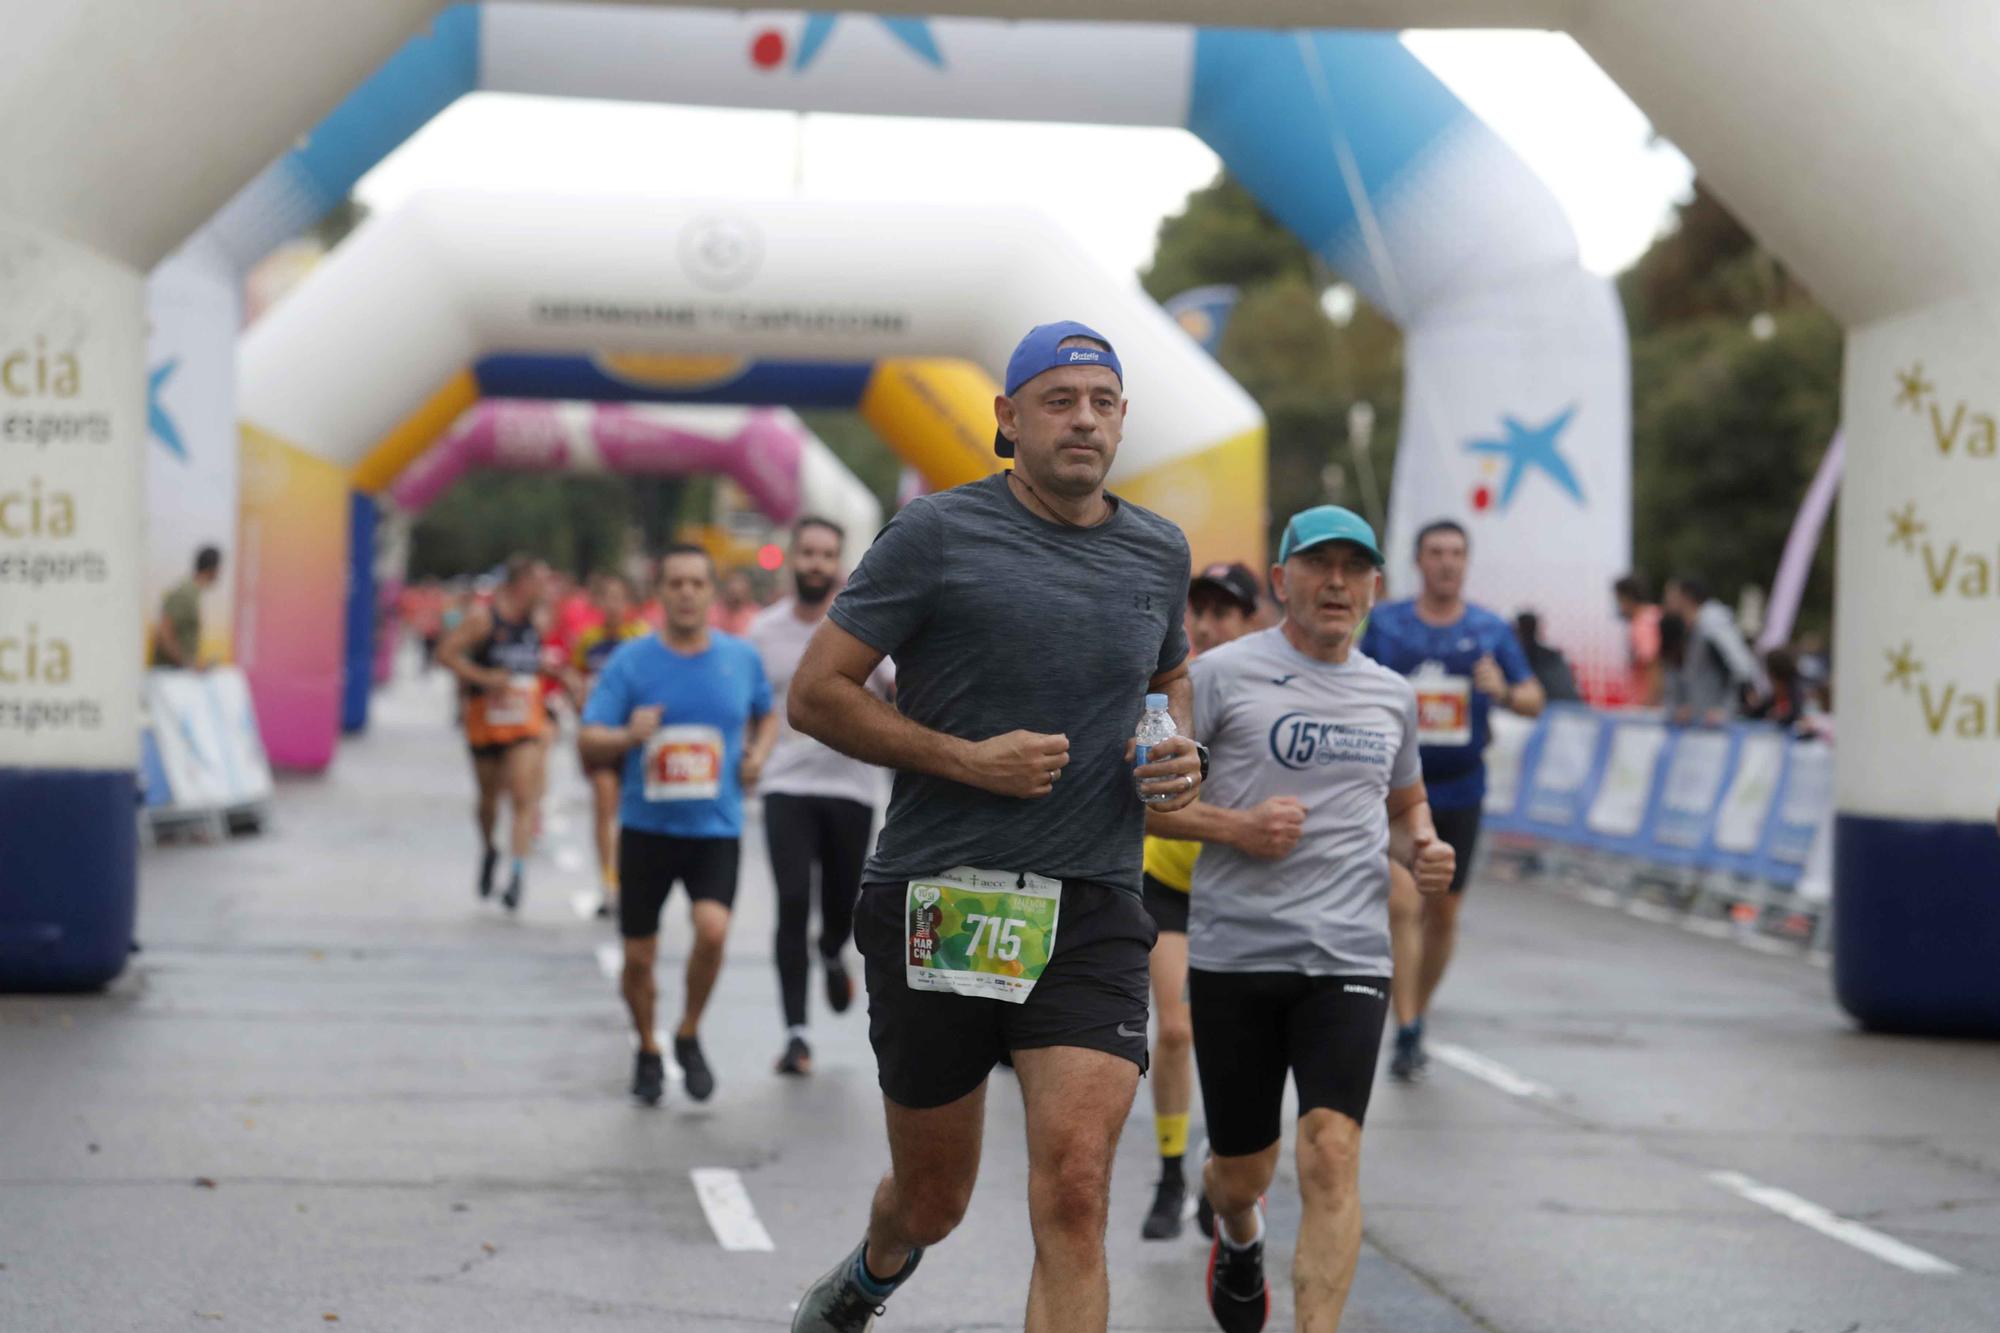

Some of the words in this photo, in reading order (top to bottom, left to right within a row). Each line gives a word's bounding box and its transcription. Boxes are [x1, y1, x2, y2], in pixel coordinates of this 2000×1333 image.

[914, 937, 932, 949] MAR
[965, 913, 1027, 961] 715
[914, 949, 932, 960] CHA
